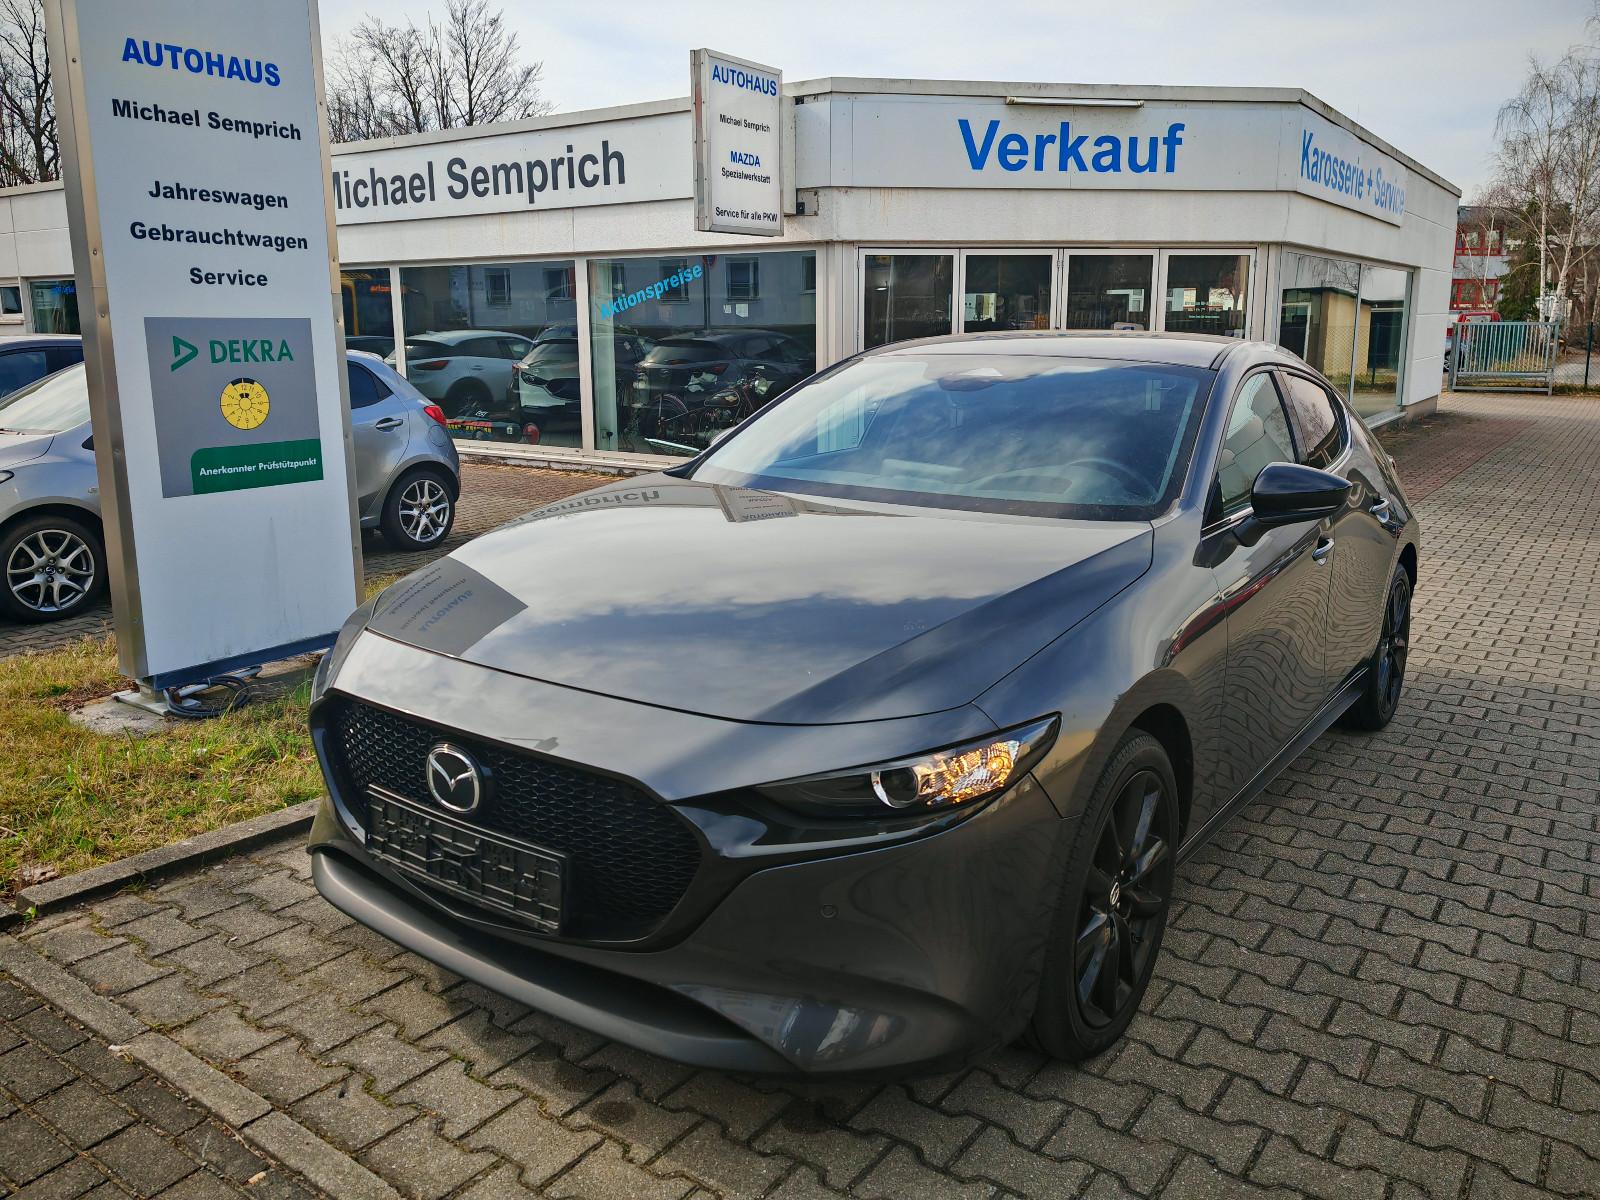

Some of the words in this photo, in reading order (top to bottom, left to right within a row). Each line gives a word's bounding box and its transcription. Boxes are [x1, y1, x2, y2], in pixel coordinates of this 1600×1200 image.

[121, 38, 281, 87] AUTOHAUS
[712, 64, 777, 97] AUTOHAUS
[111, 98, 201, 127] Michael
[207, 111, 302, 141] Semprich
[719, 113, 743, 127] Michael
[743, 118, 771, 133] Semprich
[730, 150, 761, 168] MAZDA
[957, 118, 1186, 174] Verkauf
[446, 140, 626, 204] Semprich
[721, 167, 771, 184] Spezialwerkstatt
[1300, 129, 1365, 200] Karosserie
[1367, 168, 1373, 196] +
[1374, 167, 1405, 216] Service
[148, 180, 289, 211] Jahreswagen
[715, 206, 740, 219] Service
[740, 209, 750, 220] für
[750, 211, 762, 221] alle
[762, 212, 778, 223] PKW
[129, 221, 308, 252] Gebrauchtwagen
[189, 267, 269, 287] Service
[600, 263, 704, 320] Aktionspreise
[208, 339, 295, 364] DEKRA
[199, 463, 257, 477] Anerkannter
[258, 458, 317, 473] Prüfstützpunkt
